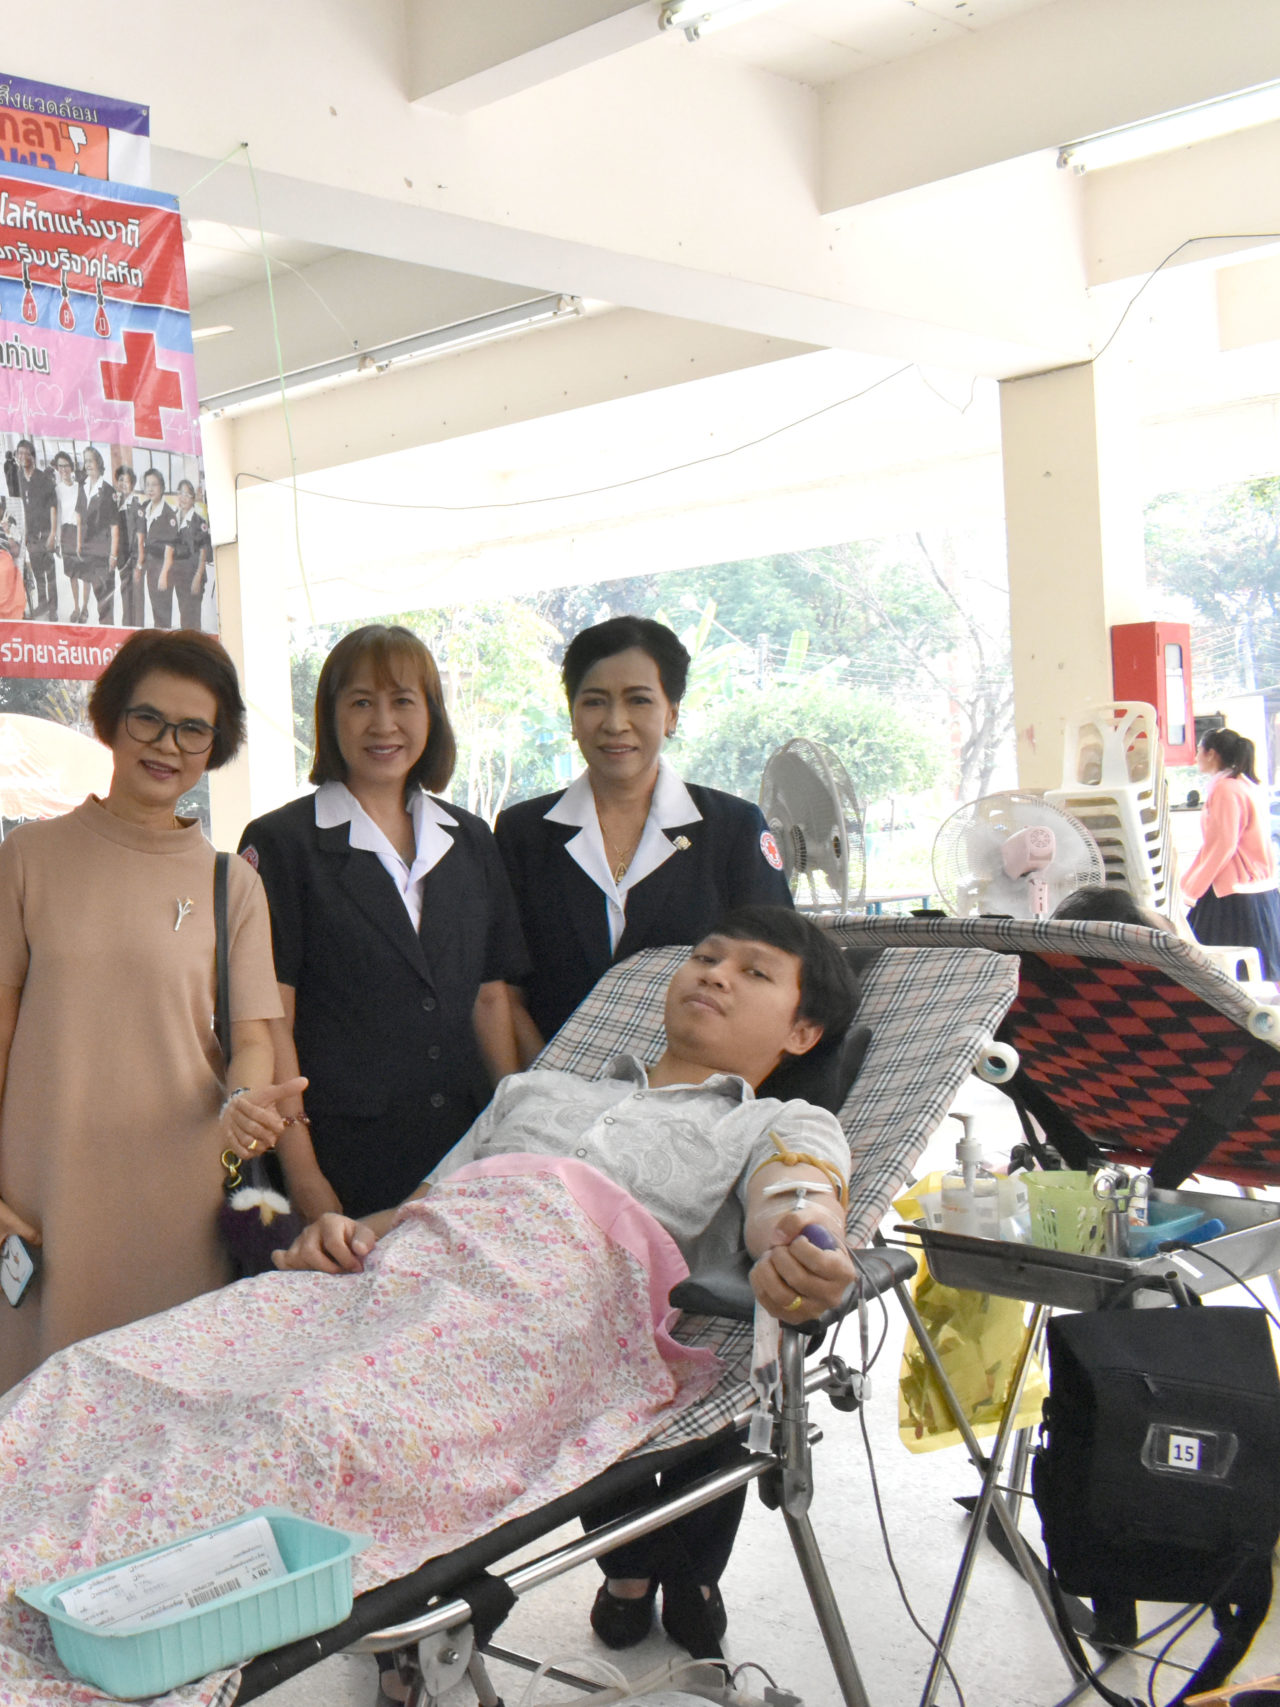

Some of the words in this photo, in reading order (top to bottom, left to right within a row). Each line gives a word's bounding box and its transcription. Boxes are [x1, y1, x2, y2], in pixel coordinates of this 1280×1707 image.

[26, 303, 34, 317] A
[63, 311, 71, 324] B
[1173, 1444, 1195, 1462] 15
